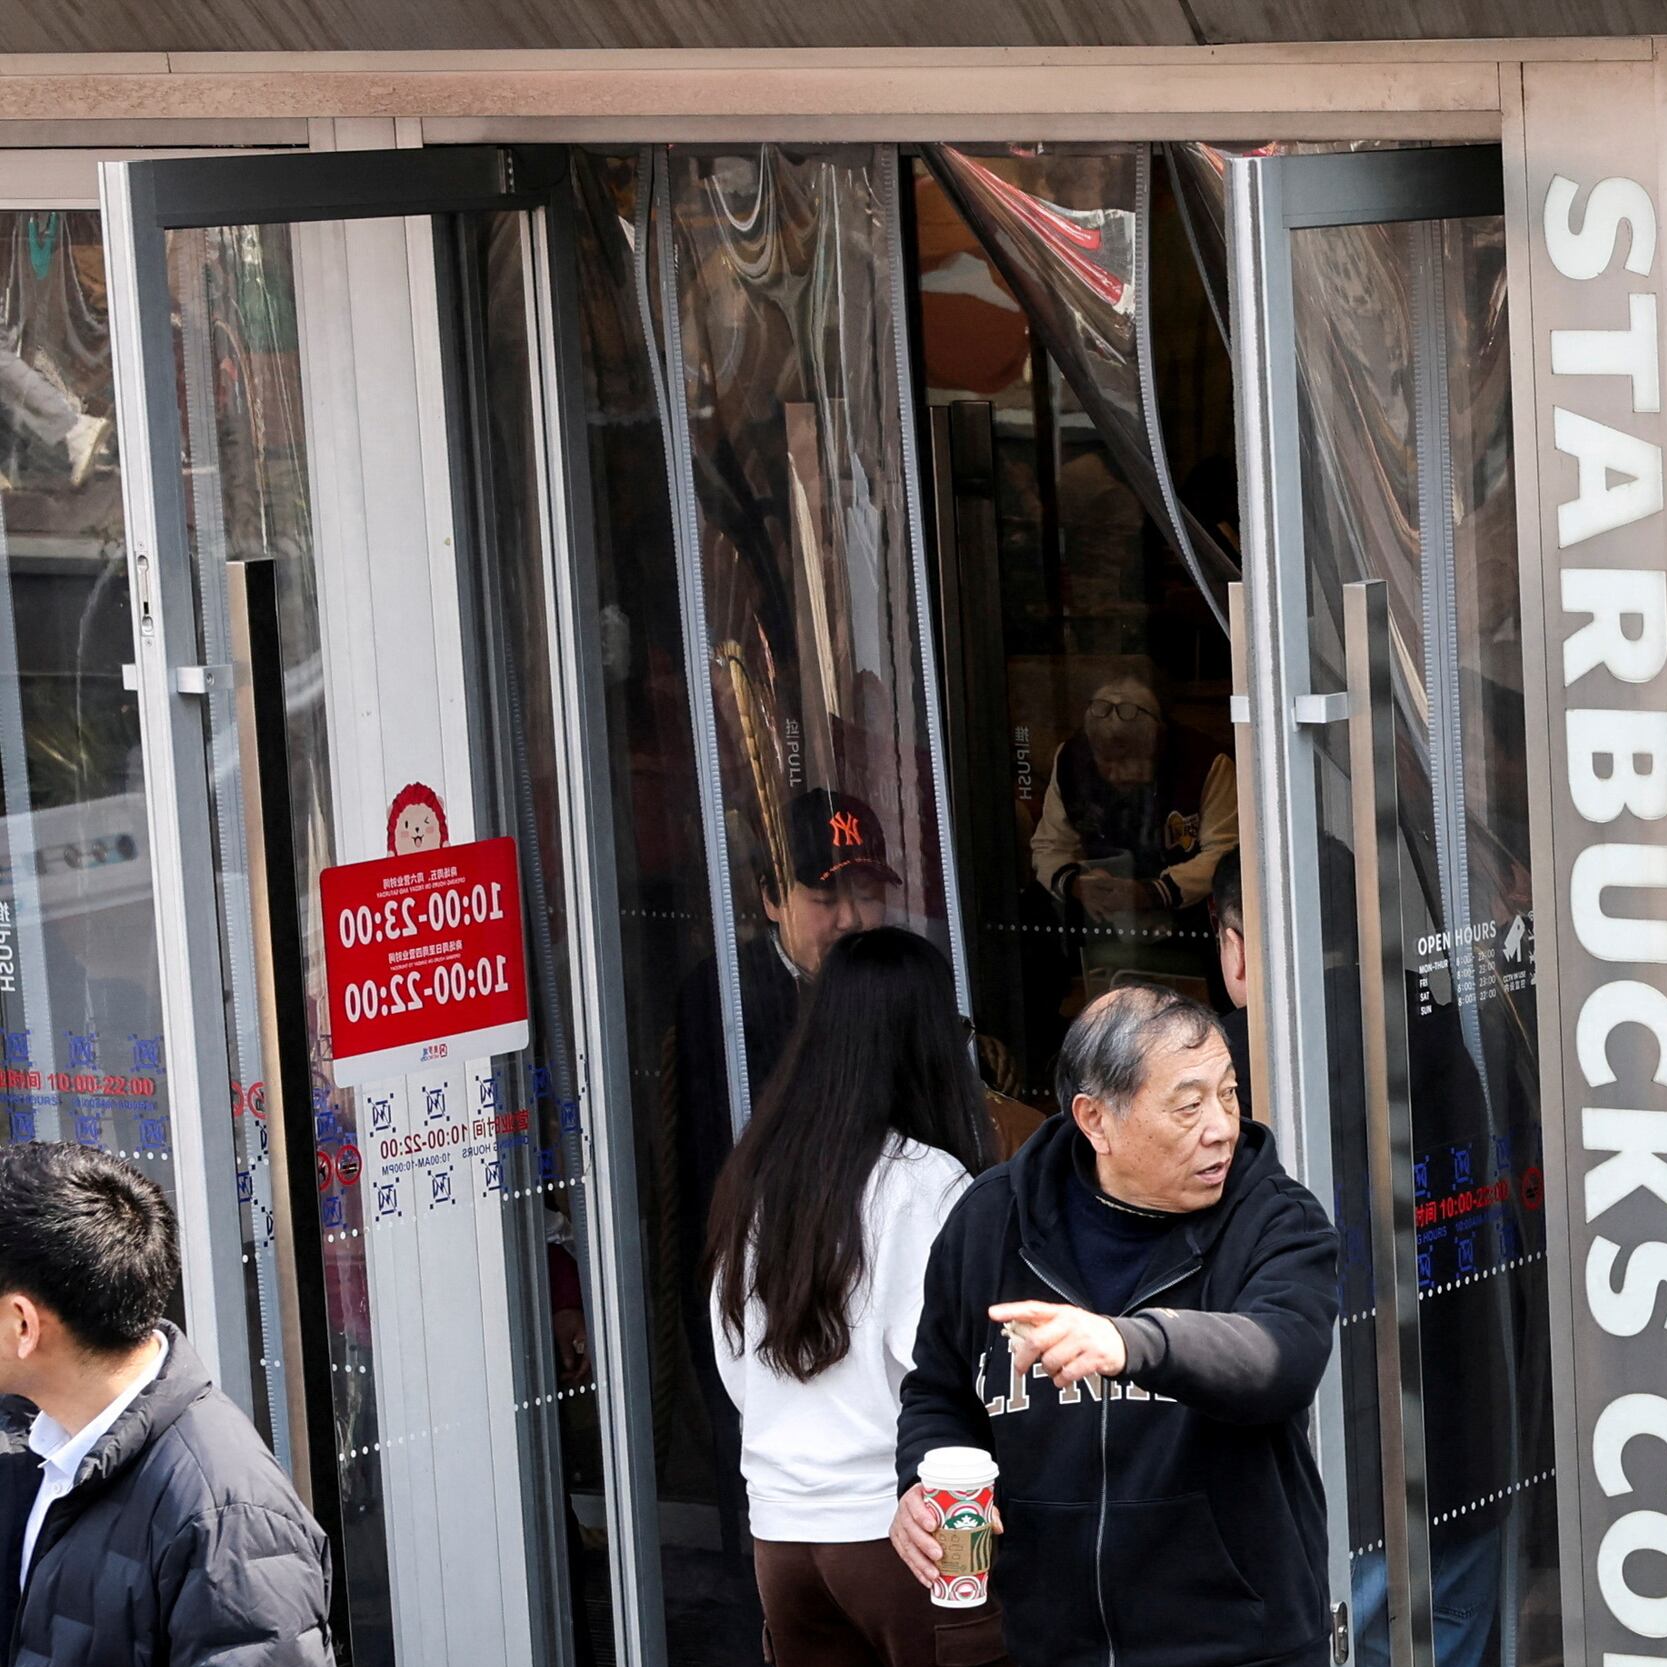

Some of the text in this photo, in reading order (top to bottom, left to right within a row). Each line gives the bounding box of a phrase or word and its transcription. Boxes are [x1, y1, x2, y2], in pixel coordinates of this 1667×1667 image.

[787, 741, 802, 787] PULL
[829, 811, 862, 847] NY
[1418, 920, 1497, 955] OPEN HOURS
[1420, 991, 1430, 1001] SAT
[1420, 1005, 1432, 1015] SUN
[47, 1073, 156, 1096] 10:00-22:00
